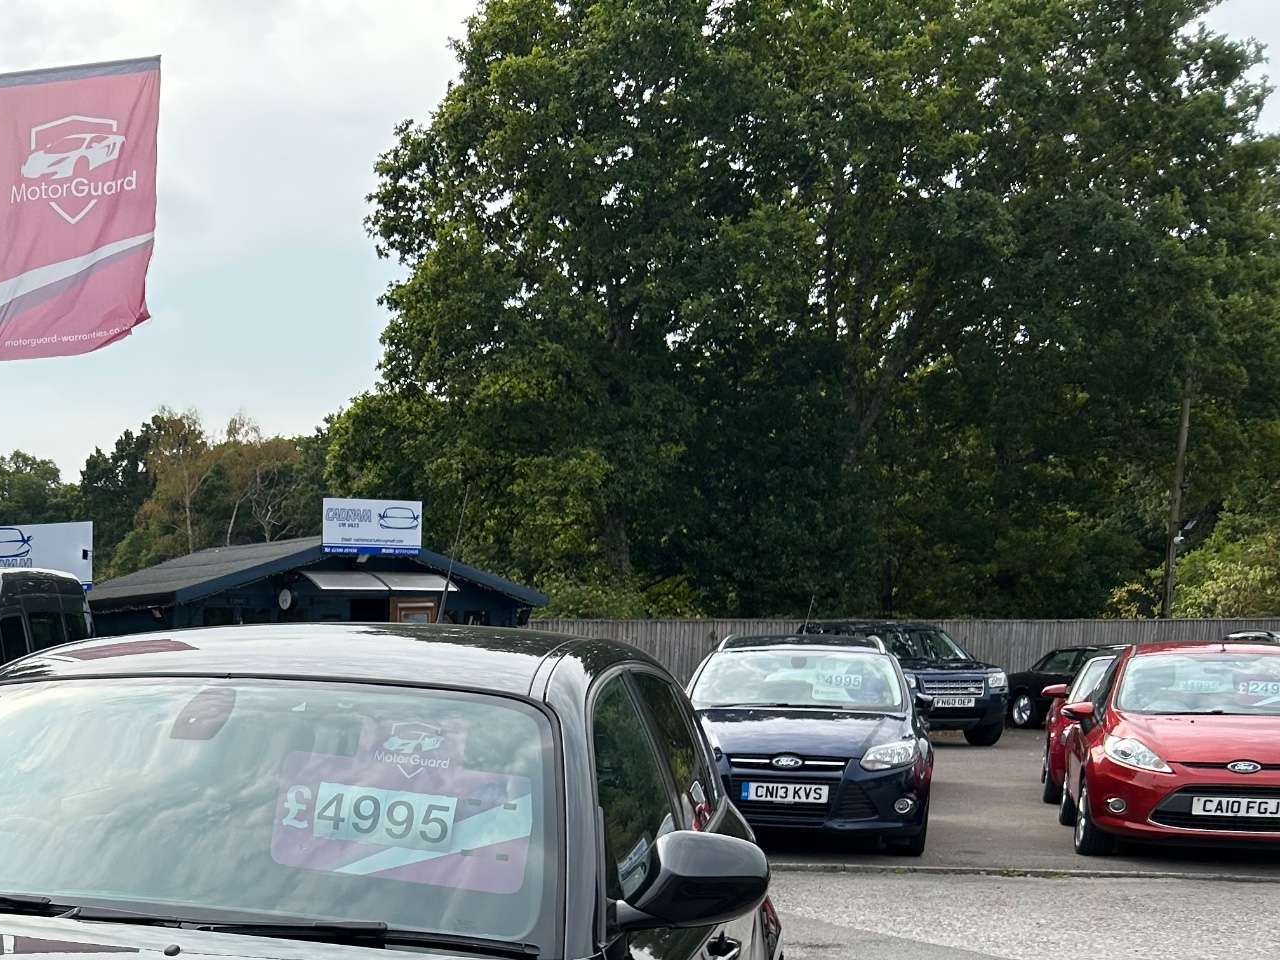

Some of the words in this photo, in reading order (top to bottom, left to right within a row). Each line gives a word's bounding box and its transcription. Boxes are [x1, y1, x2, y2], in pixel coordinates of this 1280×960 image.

[9, 170, 138, 204] MotorGuard
[374, 750, 451, 769] MotorGuard
[755, 784, 789, 799] CN13
[792, 786, 823, 801] KVS
[1202, 799, 1242, 814] CA10
[1245, 800, 1280, 815] FGJ
